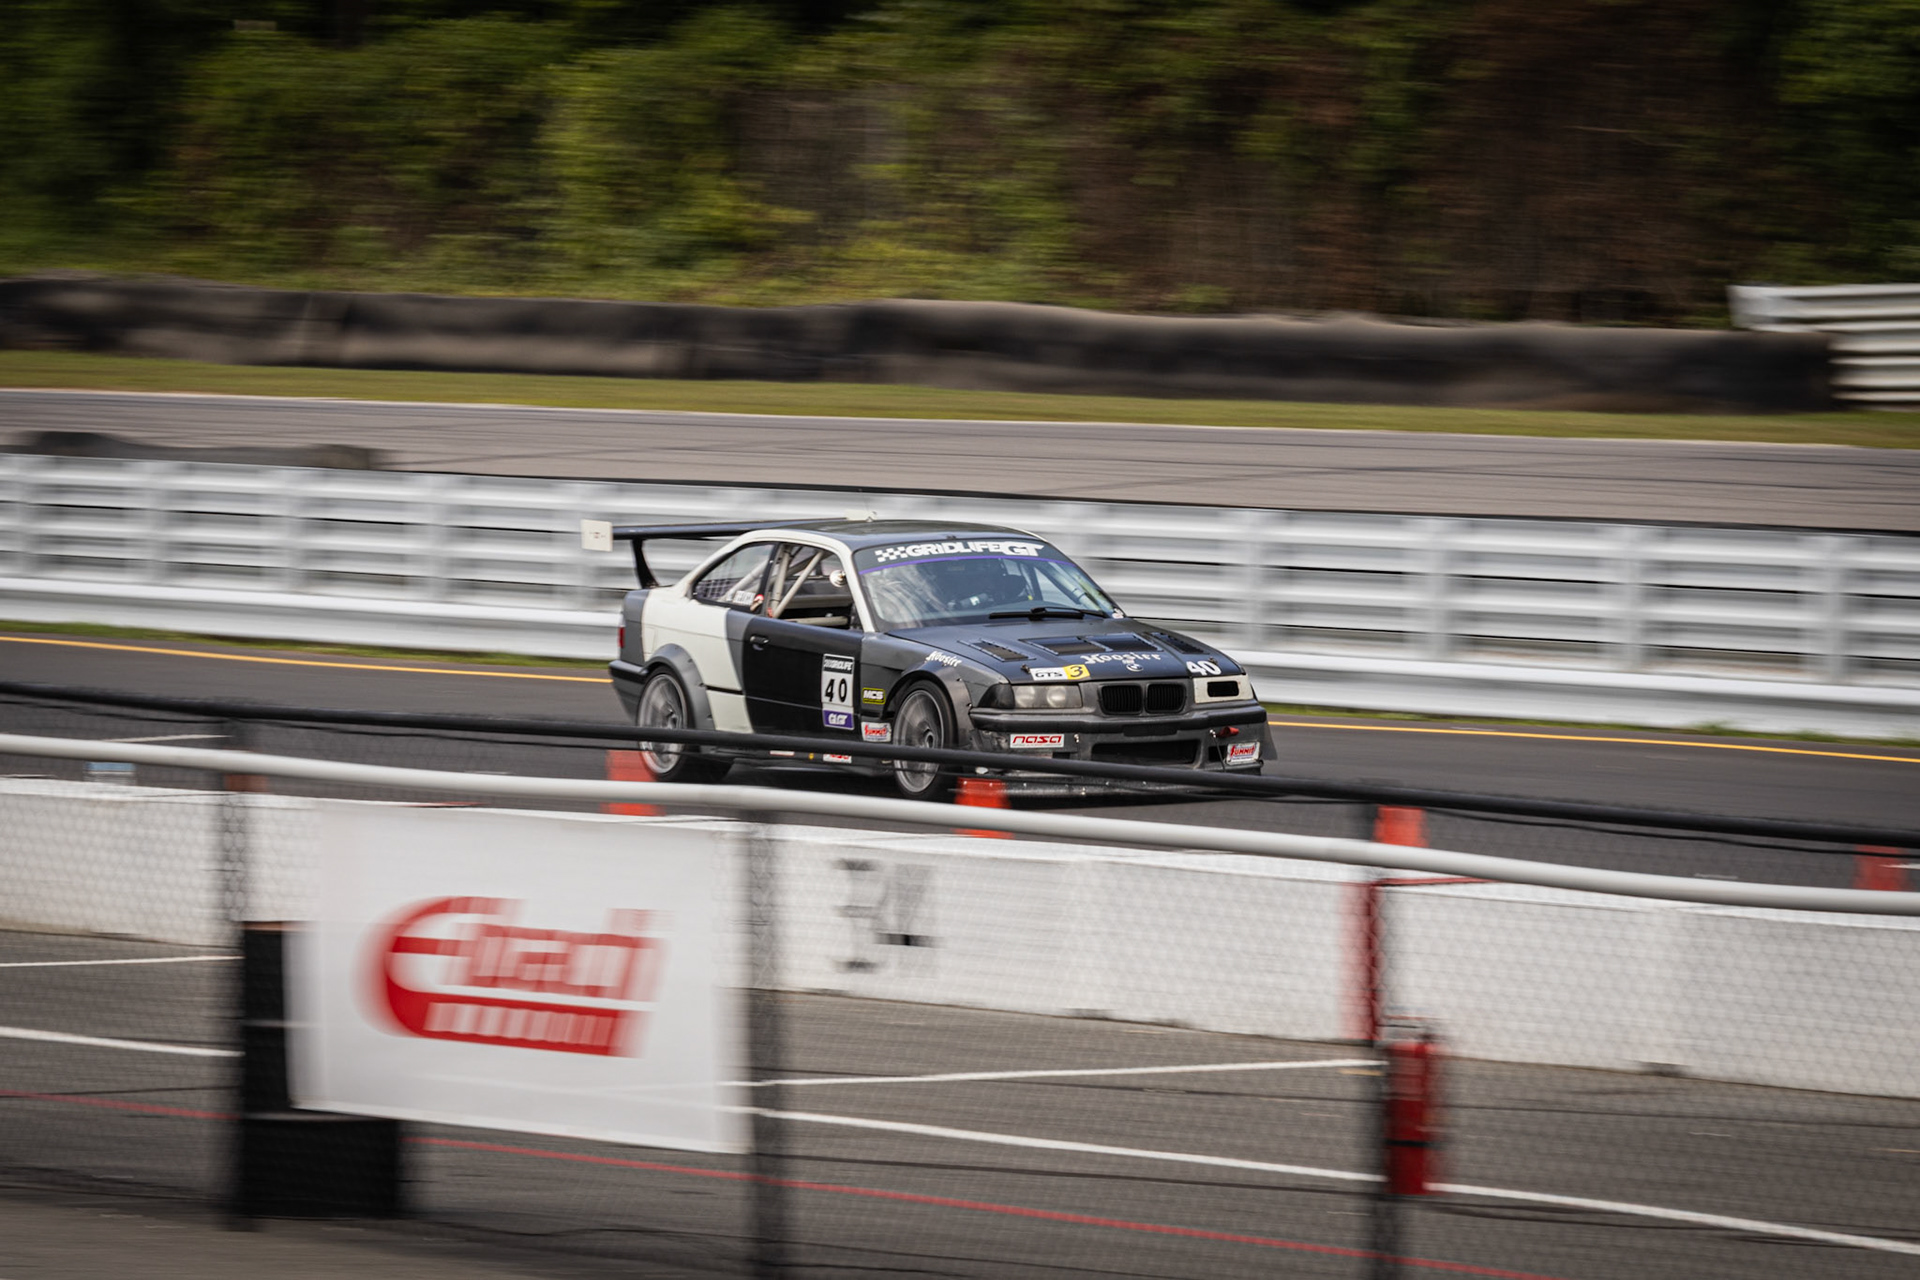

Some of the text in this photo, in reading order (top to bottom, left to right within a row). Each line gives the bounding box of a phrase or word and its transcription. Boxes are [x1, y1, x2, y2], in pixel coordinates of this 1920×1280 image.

[1035, 665, 1084, 679] GTS 3
[1186, 660, 1222, 676] 40
[825, 678, 847, 702] 40
[863, 690, 883, 700] MCS
